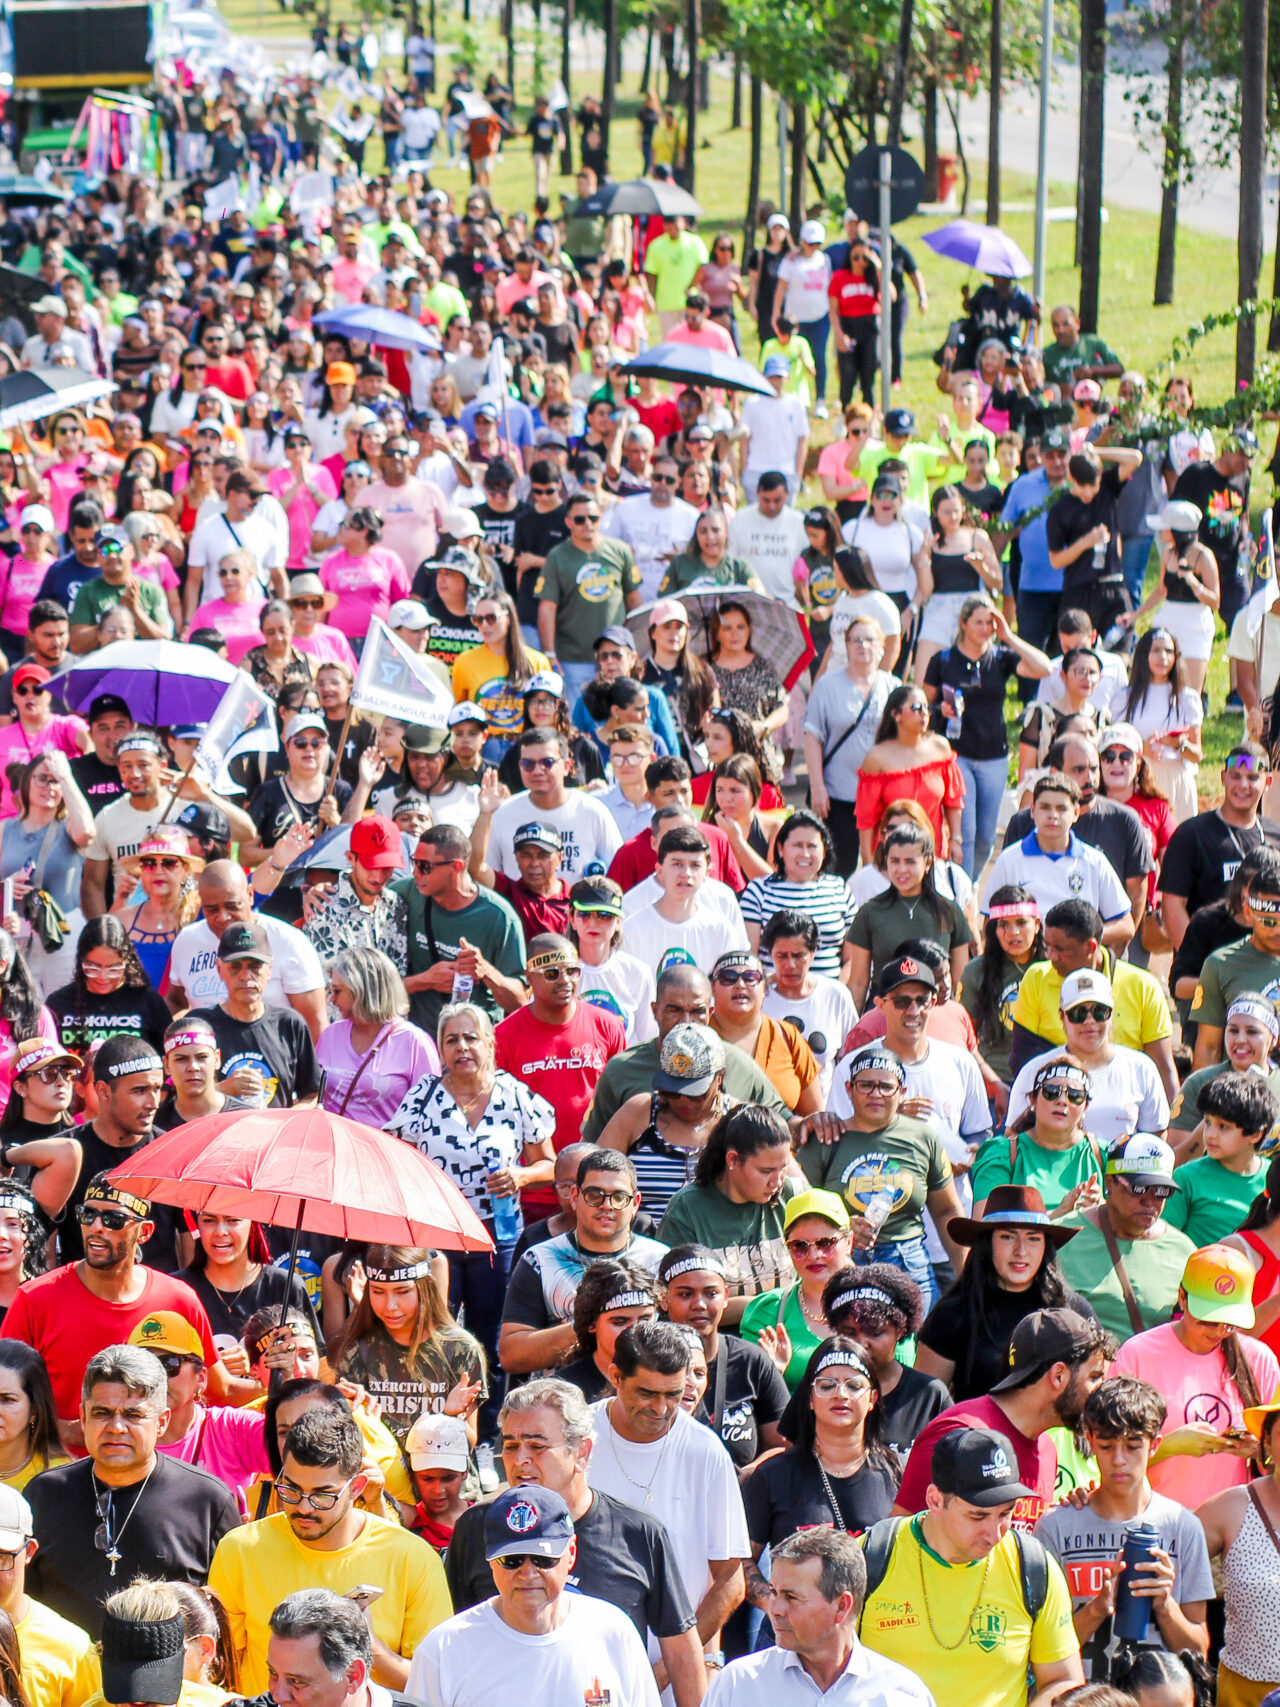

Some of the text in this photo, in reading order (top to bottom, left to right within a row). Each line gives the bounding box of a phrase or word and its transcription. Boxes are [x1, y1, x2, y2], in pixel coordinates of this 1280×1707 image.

[351, 690, 446, 724] QUADRANGULAR
[117, 843, 140, 859] PU
[531, 952, 565, 968] 100%
[16, 1047, 54, 1073] 100%
[119, 1058, 150, 1076] MARCHA
[107, 1188, 149, 1217] JESUS
[670, 1257, 702, 1278] MARCHA
[430, 1382, 446, 1393] DE
[374, 1396, 447, 1414] RISTO
[875, 1601, 914, 1614] IMPACTO
[879, 1617, 916, 1628] RADICAL
[987, 1615, 1001, 1632] R
